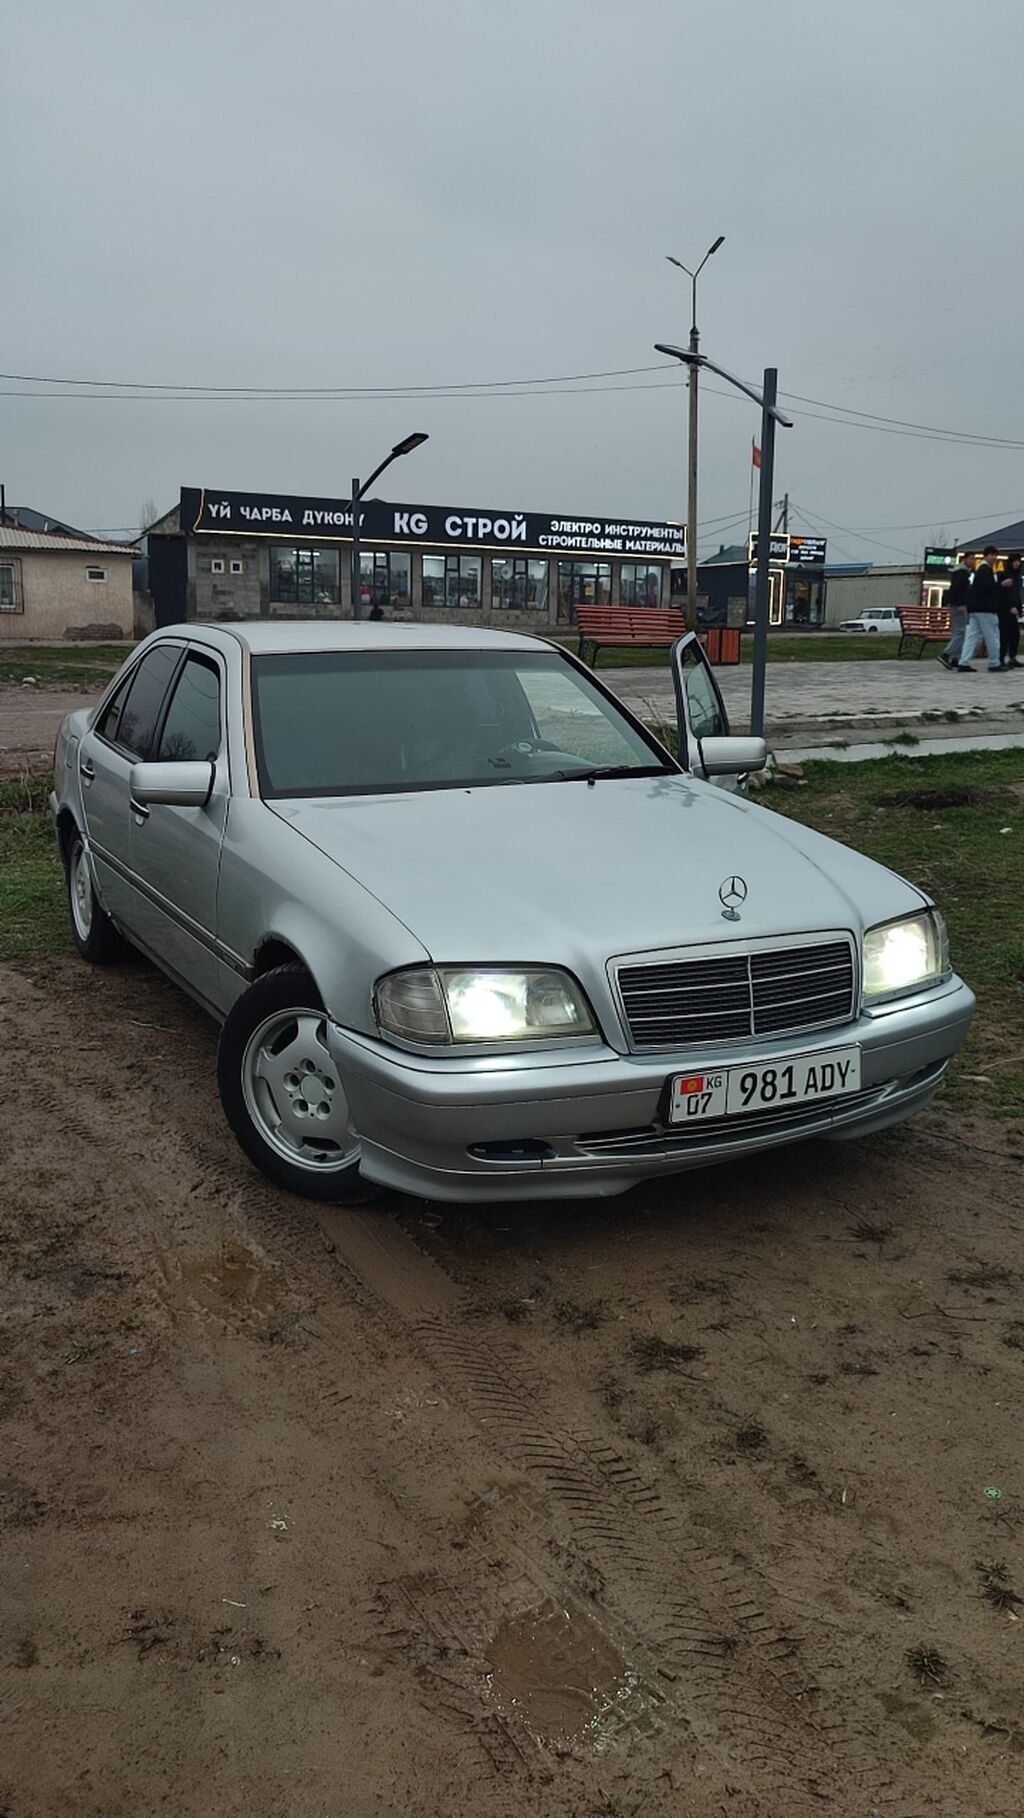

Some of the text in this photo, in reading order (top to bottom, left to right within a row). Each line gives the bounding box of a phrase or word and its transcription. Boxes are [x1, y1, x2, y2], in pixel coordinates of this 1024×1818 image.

[240, 506, 293, 522] ЧАРБА
[394, 512, 526, 540] KG СТРОЙ
[550, 520, 683, 539] ЭЛЕКТРО ИНСТРУМЕНТЫ
[538, 535, 623, 550] СТРОИТЕЛЬНЫЕ
[706, 1075, 722, 1089] KG
[739, 1059, 851, 1106] 981 ADY
[686, 1092, 713, 1116] 07
